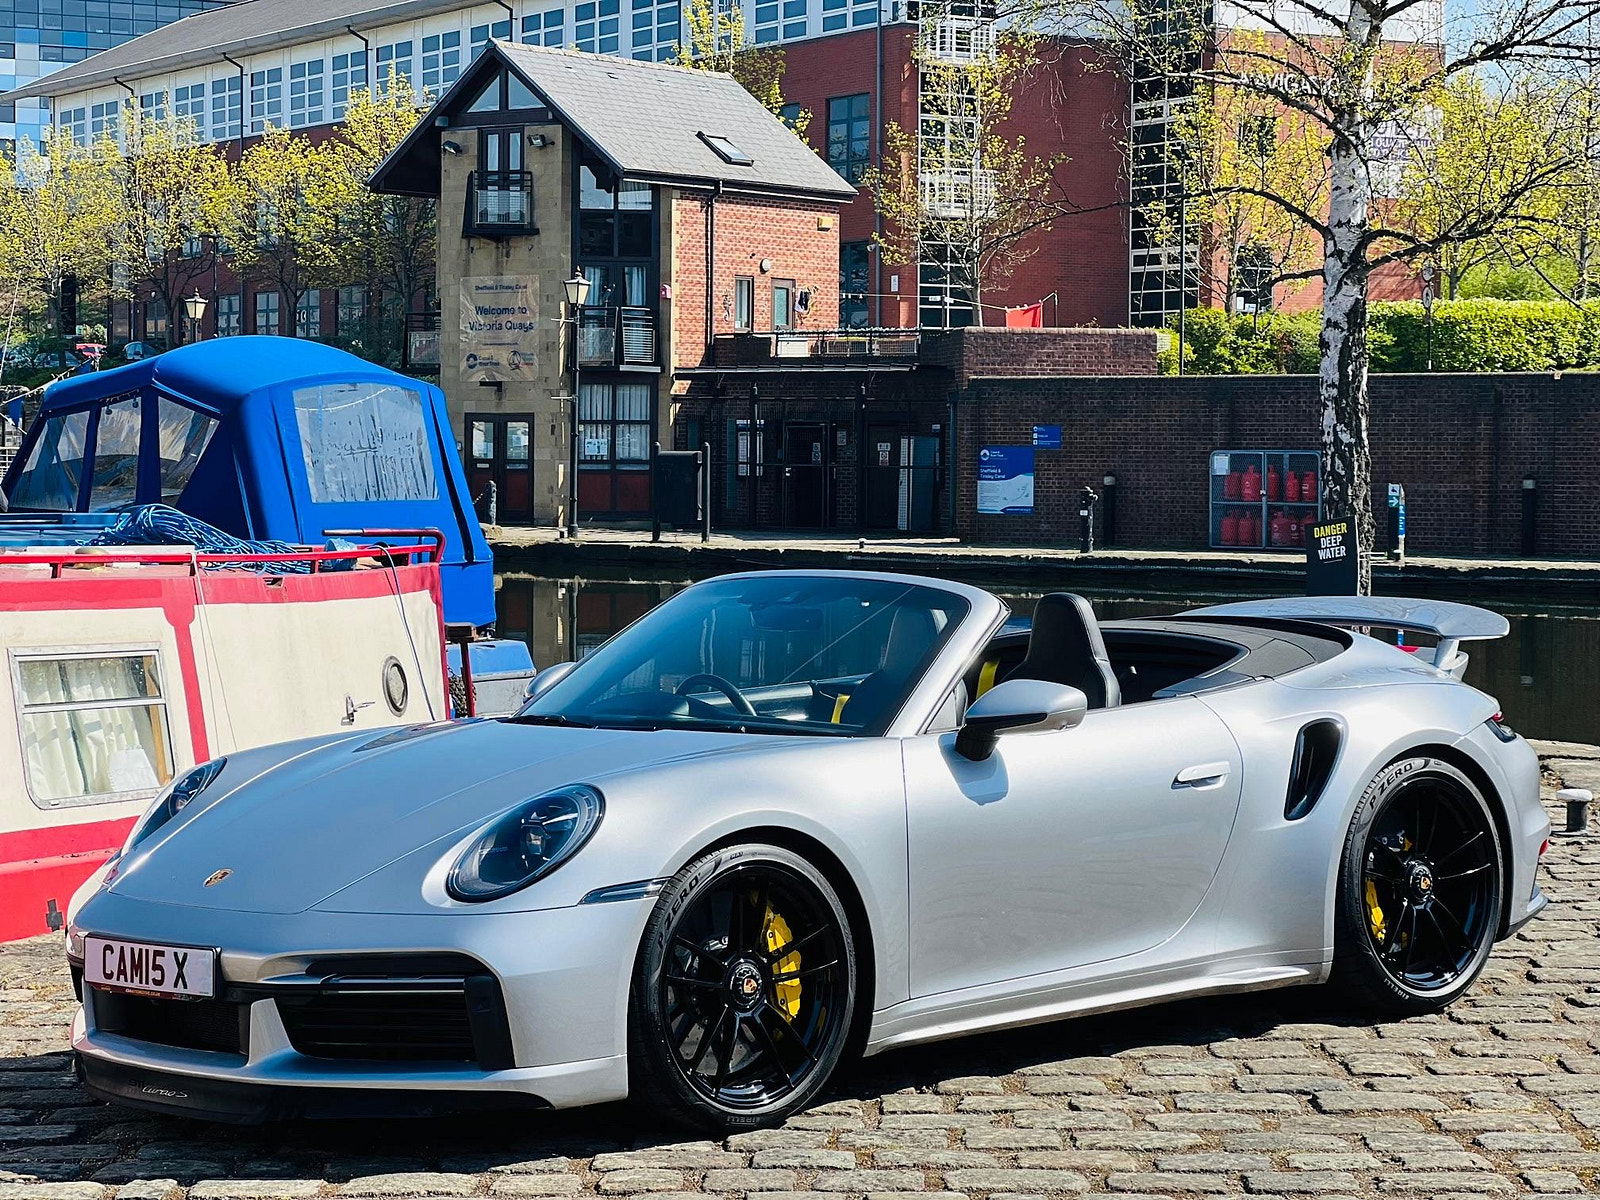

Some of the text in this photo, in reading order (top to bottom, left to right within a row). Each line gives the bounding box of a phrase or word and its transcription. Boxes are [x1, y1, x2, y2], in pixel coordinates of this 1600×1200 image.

[475, 305, 527, 315] Welcome to
[468, 321, 534, 332] Victoria Quays
[1314, 522, 1347, 538] DANGER
[1320, 535, 1342, 548] DEEP
[1317, 545, 1346, 560] WATER
[1378, 763, 1413, 796] ZERO
[665, 875, 700, 930] ZERO
[173, 952, 188, 989] X
